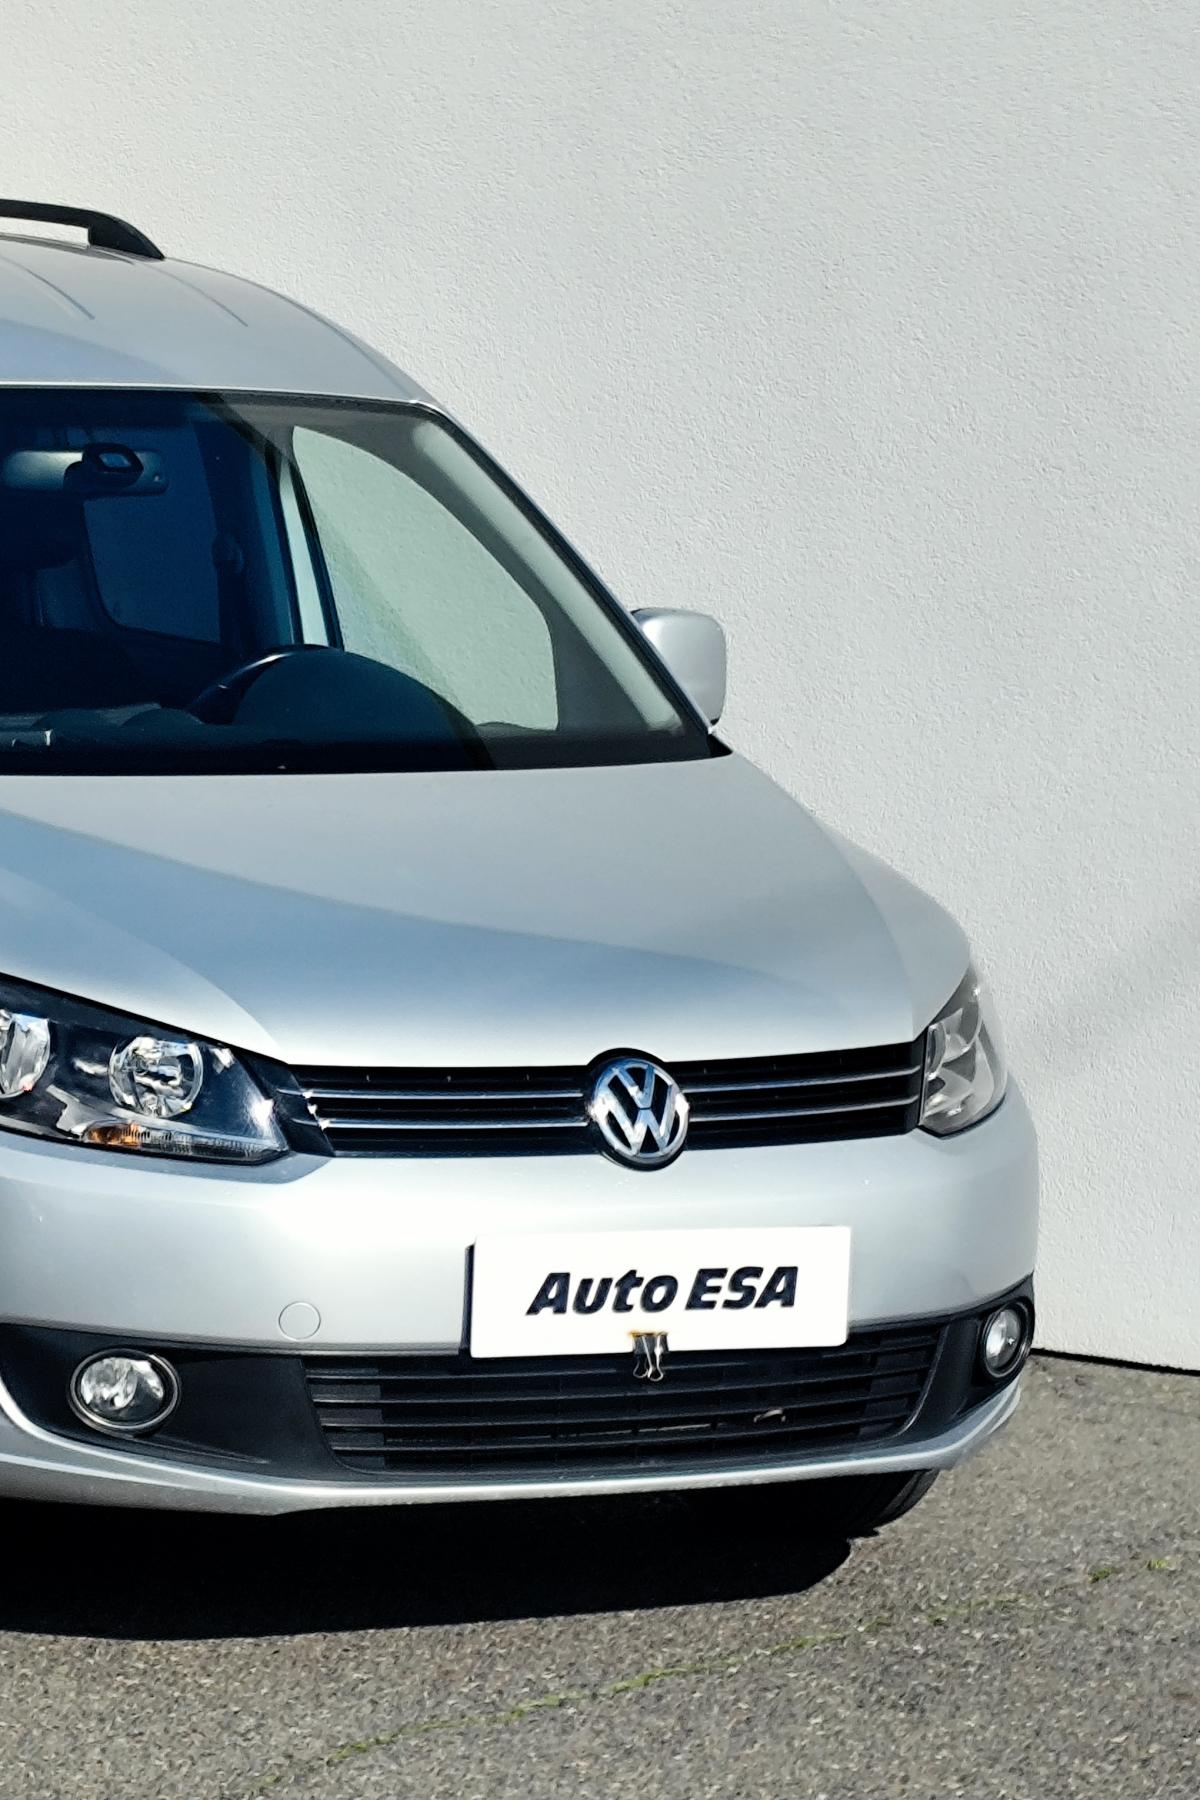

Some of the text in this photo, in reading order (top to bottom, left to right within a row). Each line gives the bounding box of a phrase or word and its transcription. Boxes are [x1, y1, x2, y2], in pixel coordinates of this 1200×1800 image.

[596, 1060, 685, 1157] VW
[525, 1265, 799, 1316] Auto ESA
